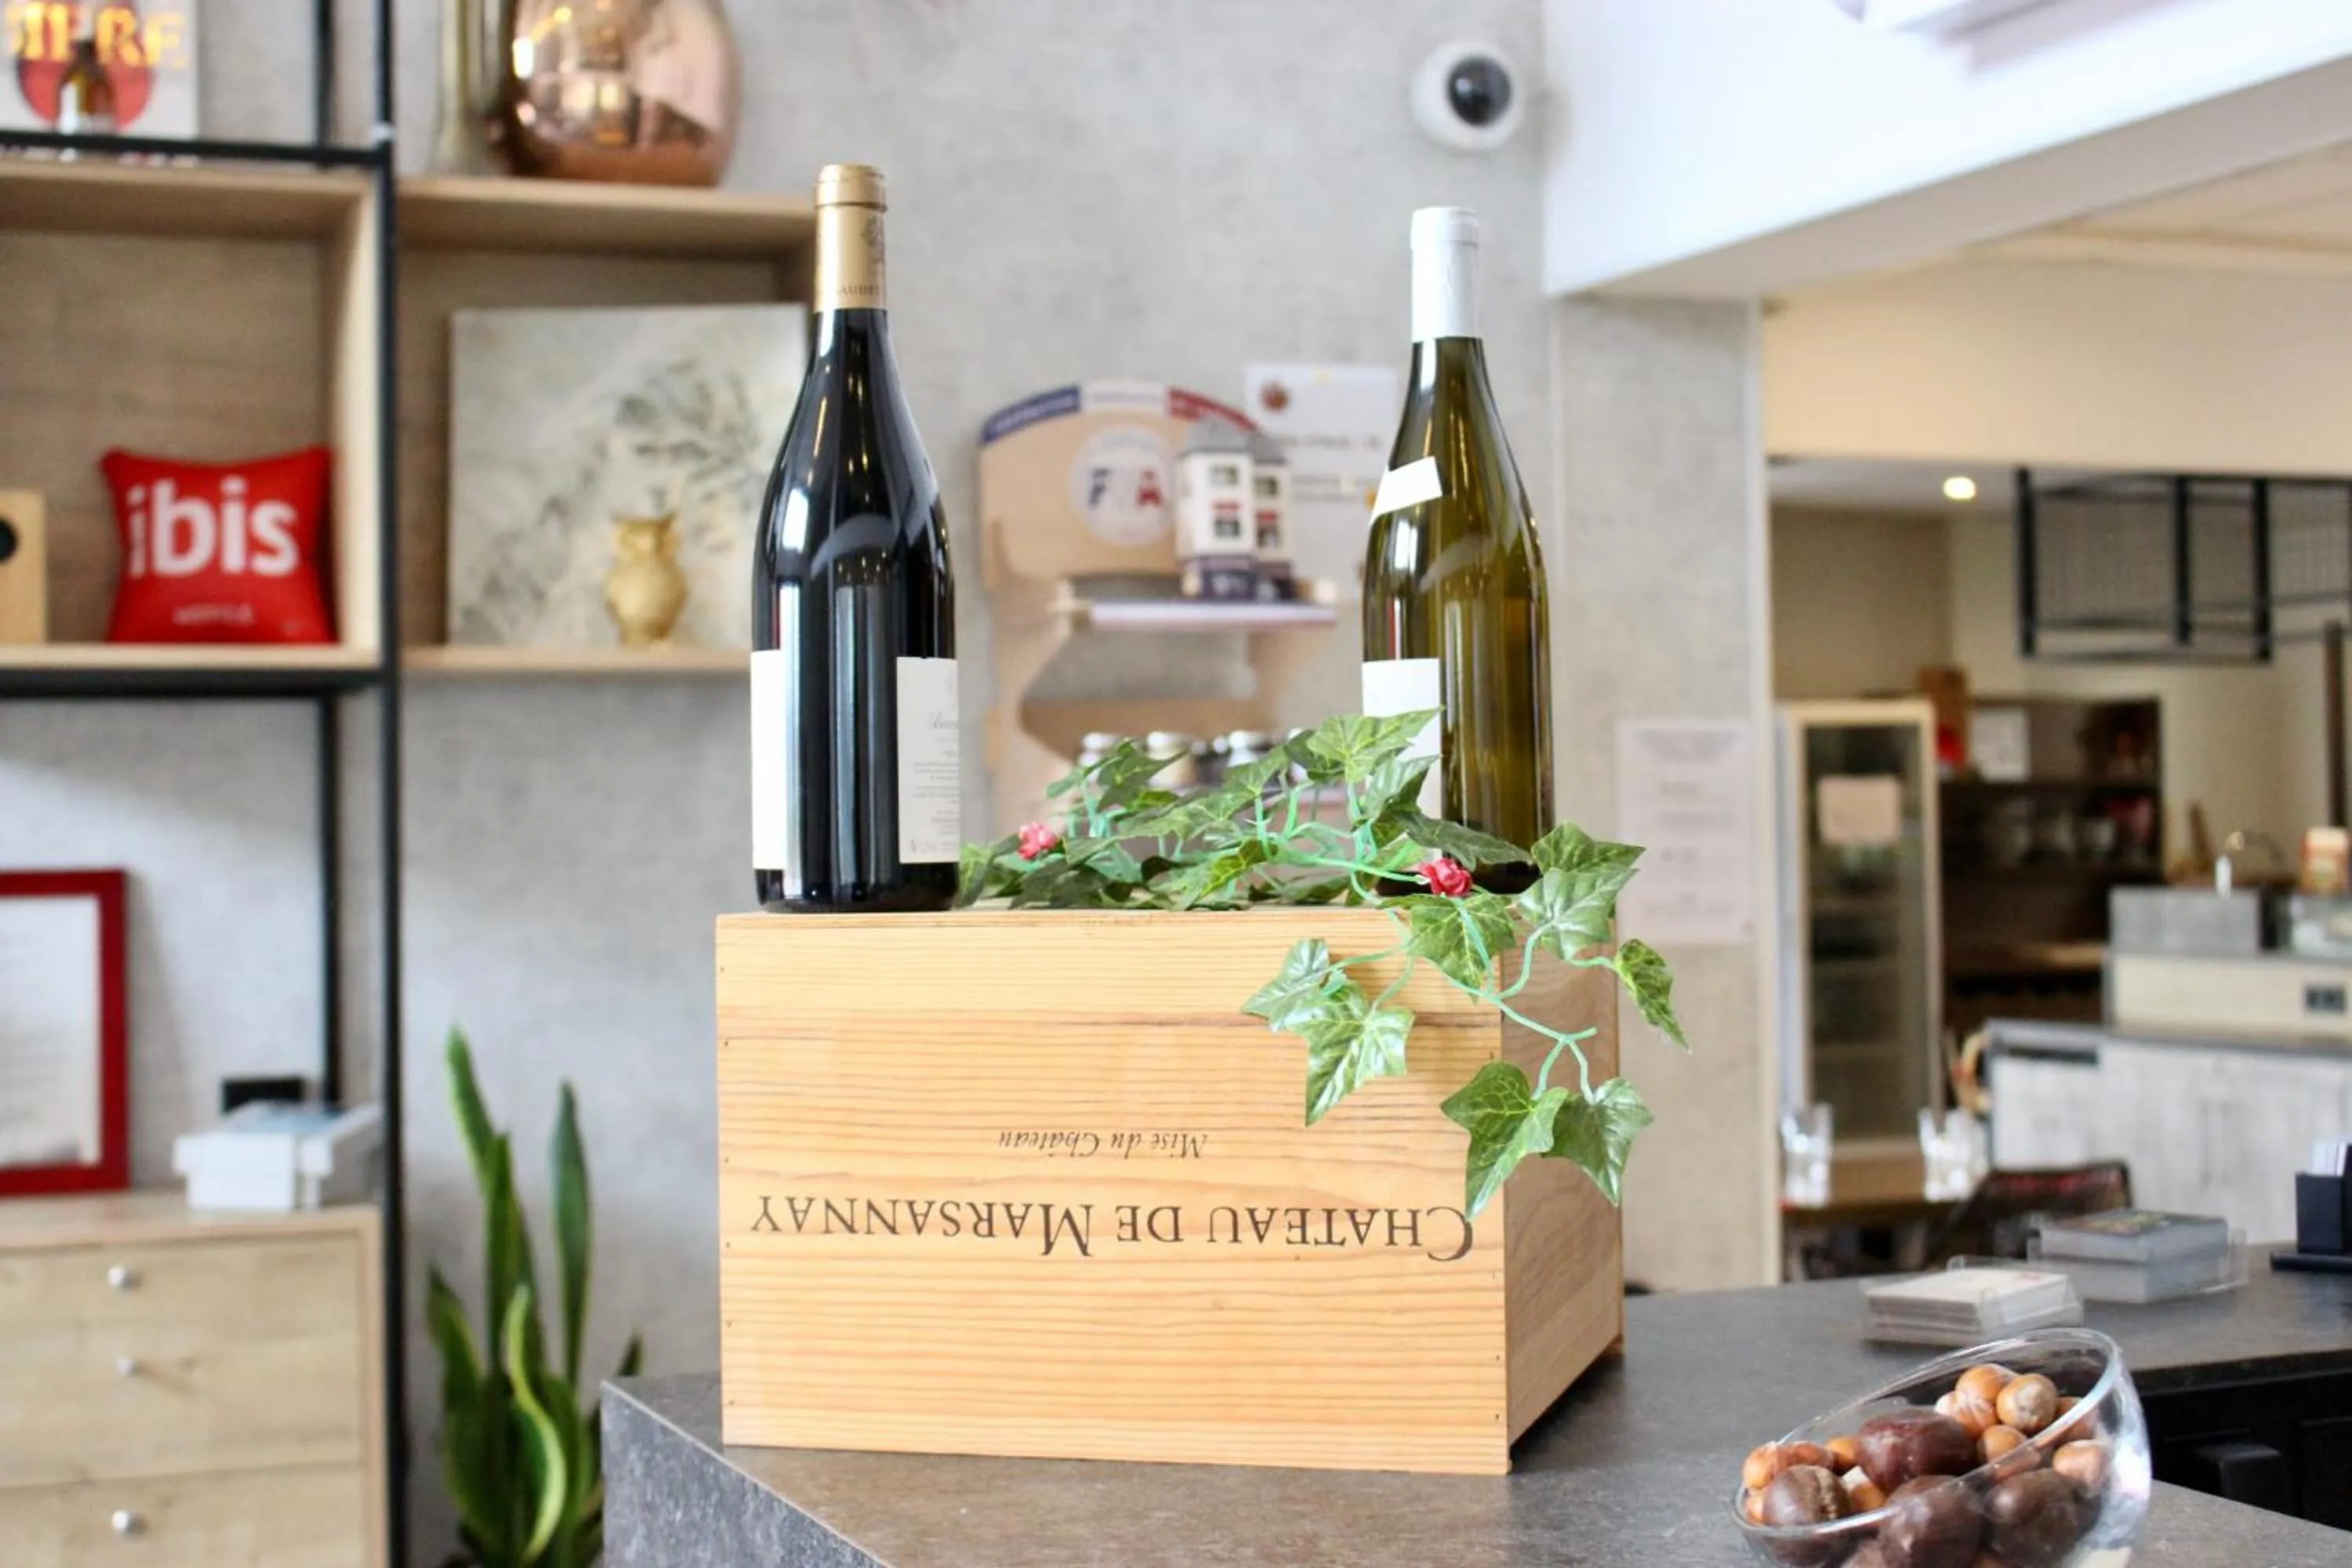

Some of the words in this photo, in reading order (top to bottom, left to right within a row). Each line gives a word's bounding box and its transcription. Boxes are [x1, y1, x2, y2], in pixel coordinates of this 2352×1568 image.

[126, 474, 300, 579] ibis
[1110, 1132, 1142, 1160] du
[1150, 1131, 1208, 1159] Mise
[750, 1196, 1094, 1257] MARSANNAY
[1115, 1205, 1184, 1243] DE
[1207, 1206, 1473, 1261] CHATEAU
